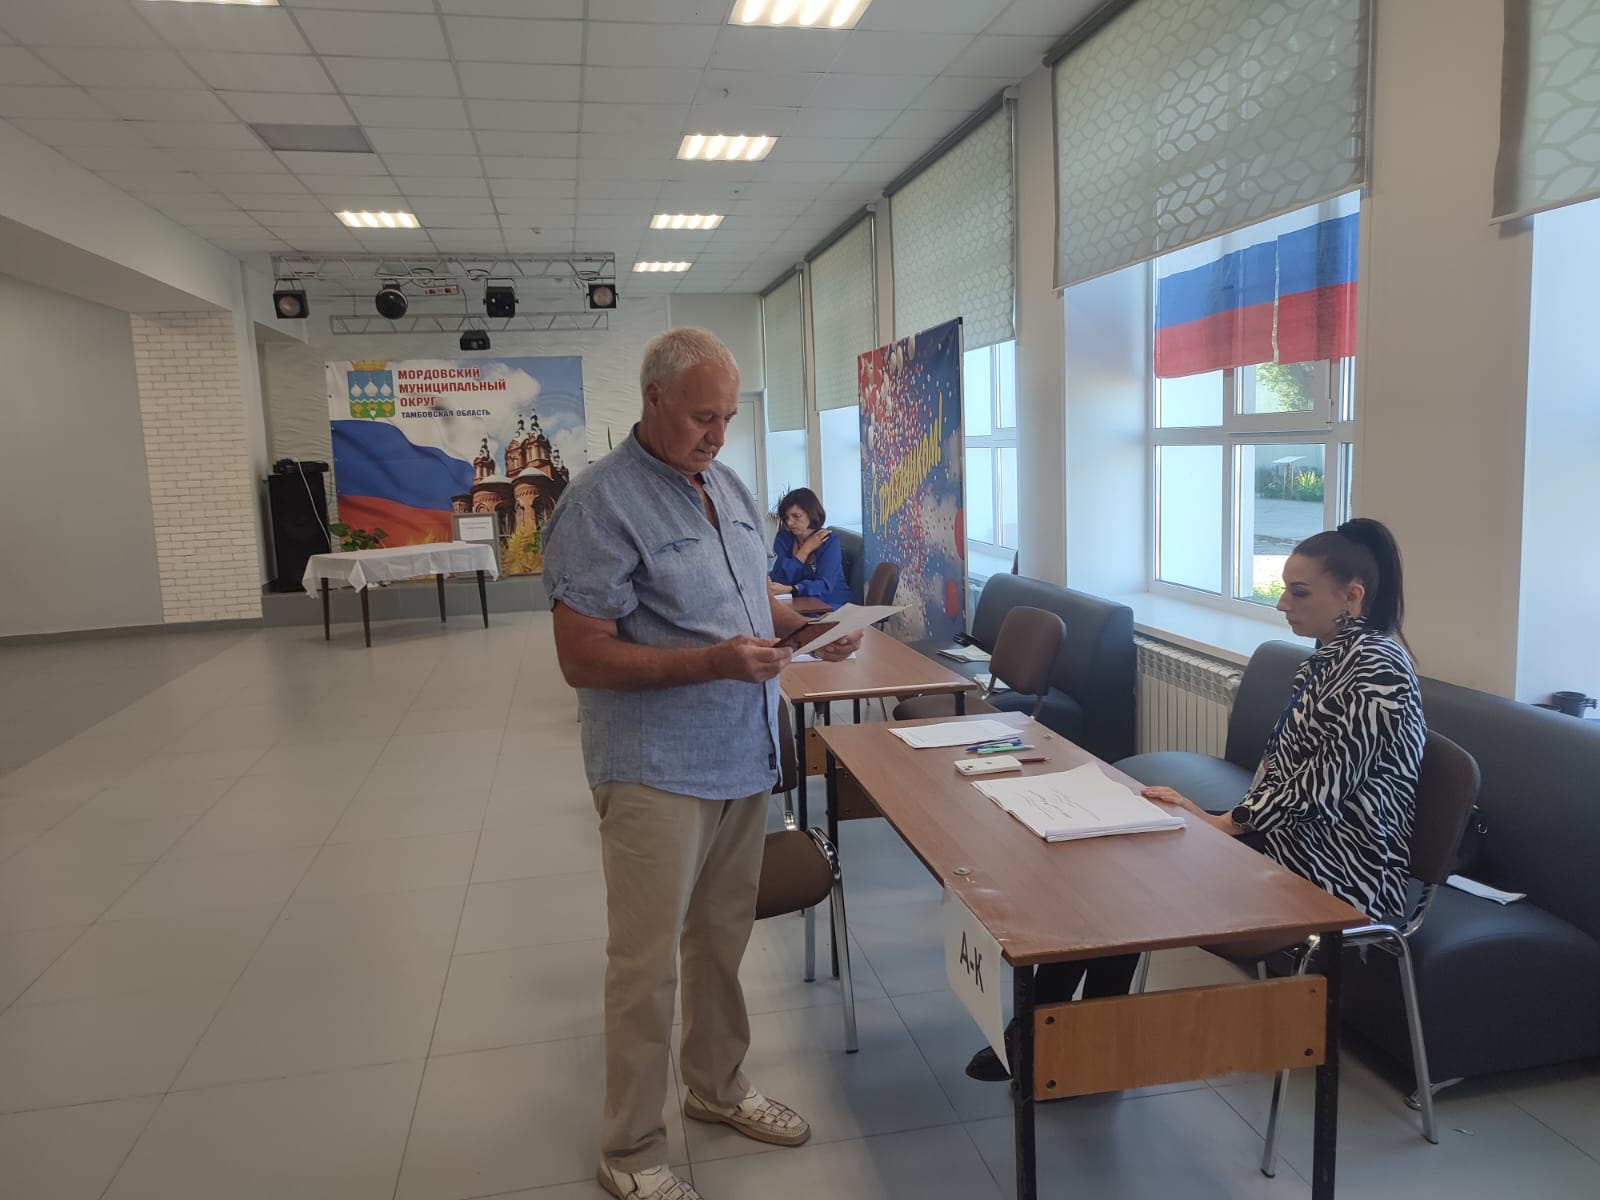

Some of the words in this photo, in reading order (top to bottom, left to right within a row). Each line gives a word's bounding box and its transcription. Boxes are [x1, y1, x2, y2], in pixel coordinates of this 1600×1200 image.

[398, 367, 480, 380] МОРДОВСКИЙ
[399, 379, 506, 394] МУНИЦИПАЛЬНЫЙ
[400, 397, 436, 407] ОКРУГ
[401, 410, 454, 419] ТАМБОВСКАЯ
[456, 409, 491, 417] ОБЛАСТЬ
